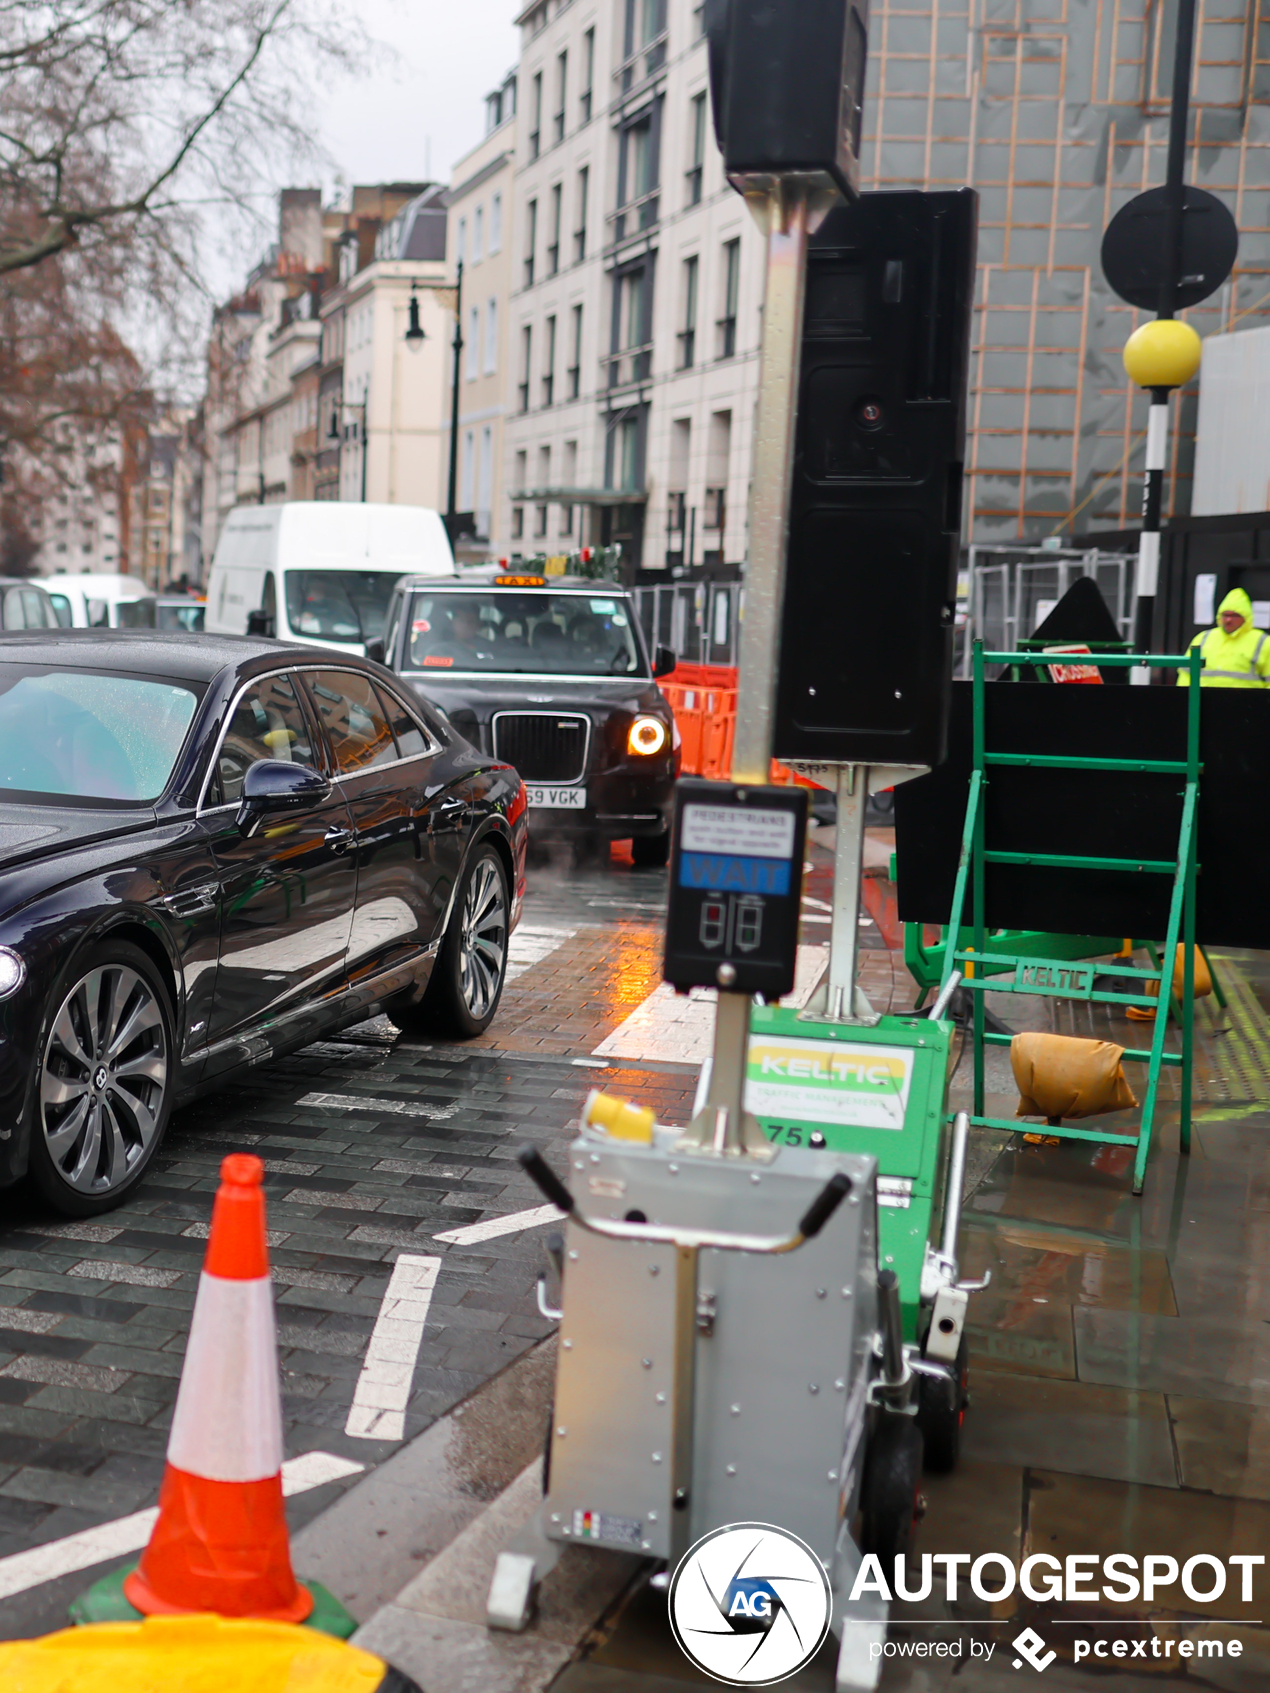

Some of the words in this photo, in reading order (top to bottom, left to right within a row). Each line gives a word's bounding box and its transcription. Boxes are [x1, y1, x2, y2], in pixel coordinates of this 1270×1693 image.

[499, 576, 540, 586] TAXI
[549, 790, 579, 805] VGK
[688, 855, 784, 890] WAIT
[1022, 965, 1088, 991] KELTIC
[761, 1055, 890, 1085] KELTIC
[756, 1086, 801, 1100] TRAFFIC
[767, 1124, 803, 1148] 75
